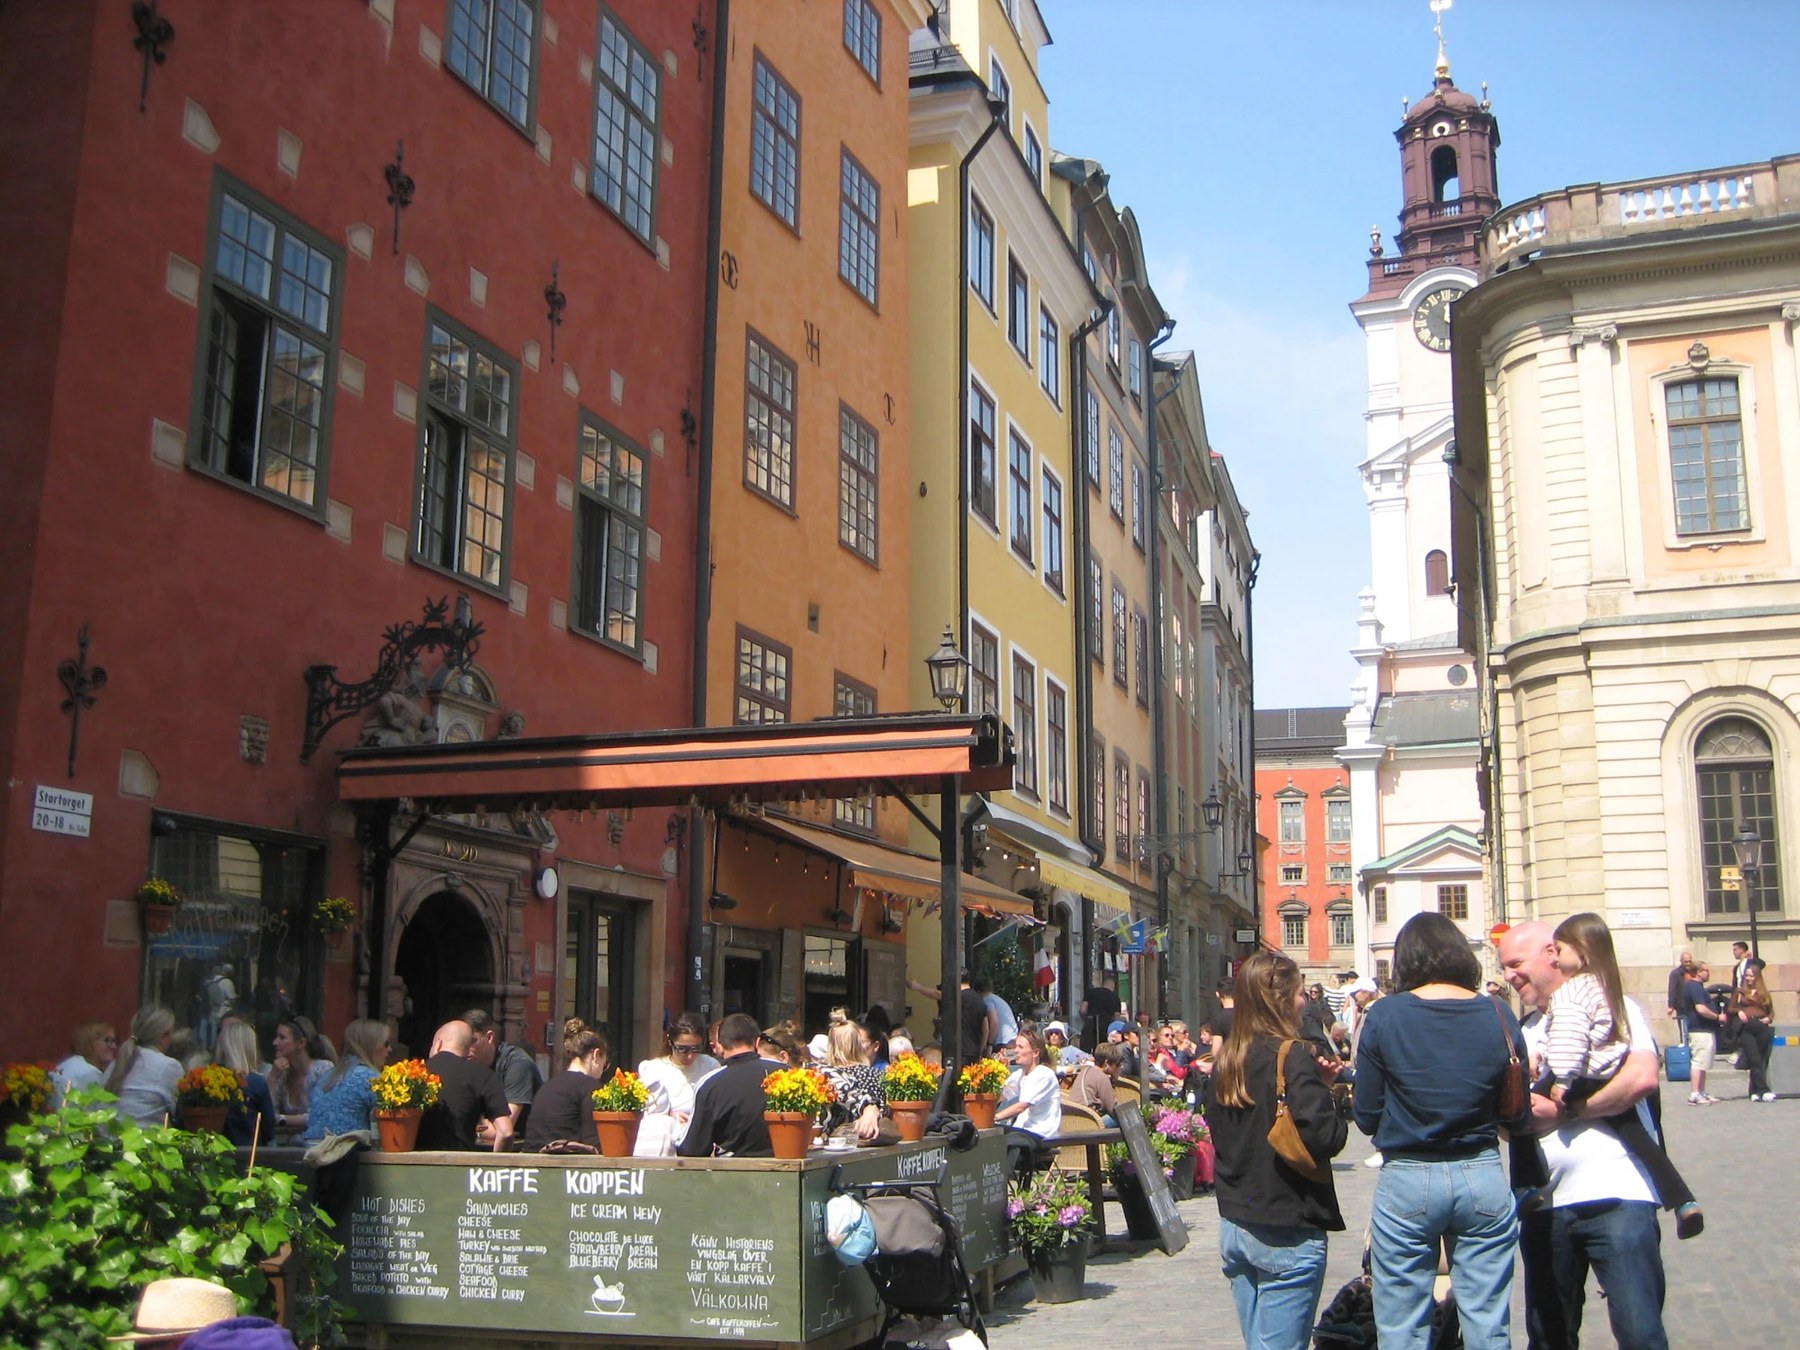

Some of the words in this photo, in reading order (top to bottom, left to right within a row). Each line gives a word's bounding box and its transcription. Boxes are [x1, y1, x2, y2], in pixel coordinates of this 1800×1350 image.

[38, 790, 86, 811] Stortorget
[36, 813, 65, 829] 20-18
[469, 1168, 539, 1193] KAFFE
[566, 1169, 645, 1195] KOPPEN
[362, 1196, 382, 1212] HOT
[389, 1198, 426, 1214] DISHES
[466, 1199, 528, 1217] SANDWICHES
[381, 1214, 395, 1223] THE
[397, 1214, 411, 1227] DAY
[458, 1216, 492, 1227] CHEESE
[571, 1203, 588, 1219] ICE
[592, 1203, 627, 1219] CREAM
[633, 1204, 662, 1225] MENY
[458, 1227, 477, 1239] HAM
[478, 1229, 484, 1239] &
[486, 1228, 521, 1240] CHEESE
[569, 1230, 618, 1243] CHOCOLATE
[622, 1234, 632, 1243] DE
[634, 1233, 654, 1245] LUXE
[352, 1236, 394, 1248] HOMEMADE
[400, 1238, 416, 1248] PIES
[458, 1240, 490, 1254] TURKEY
[569, 1241, 625, 1258] STRAWBERRY
[629, 1245, 658, 1257] DREAM
[691, 1233, 718, 1248] KÄNN
[725, 1236, 774, 1251] HISTORIENS
[387, 1250, 397, 1259] OF
[399, 1250, 412, 1260] THE
[415, 1250, 430, 1263] DAY
[494, 1255, 500, 1264] &
[502, 1253, 519, 1264] BRIE
[569, 1254, 620, 1271] BLUEBERRY
[627, 1257, 658, 1271] DREAM
[697, 1249, 737, 1262] VINGSLAG
[742, 1249, 768, 1263] ÖVER
[390, 1262, 409, 1272] MEAT
[420, 1262, 438, 1275] VEG
[459, 1263, 494, 1276] COTTAGE
[499, 1265, 529, 1277] CHEESE
[691, 1259, 702, 1271] EN
[706, 1260, 730, 1272] KOPP
[734, 1262, 763, 1273] KAFFE
[768, 1262, 772, 1273] I
[352, 1271, 378, 1283] BAKED
[380, 1272, 409, 1283] POTATO
[415, 1276, 432, 1284] WITH
[459, 1274, 498, 1288] SEAFOOD
[686, 1271, 708, 1283] VÅRT
[714, 1271, 775, 1286] KÄLLARVALV
[395, 1284, 426, 1297] CHICKEN
[427, 1286, 449, 1300] CURRY
[459, 1285, 497, 1299] CHICKEN
[502, 1288, 525, 1302] CURRY
[691, 1287, 768, 1311] VÄLKOMNA
